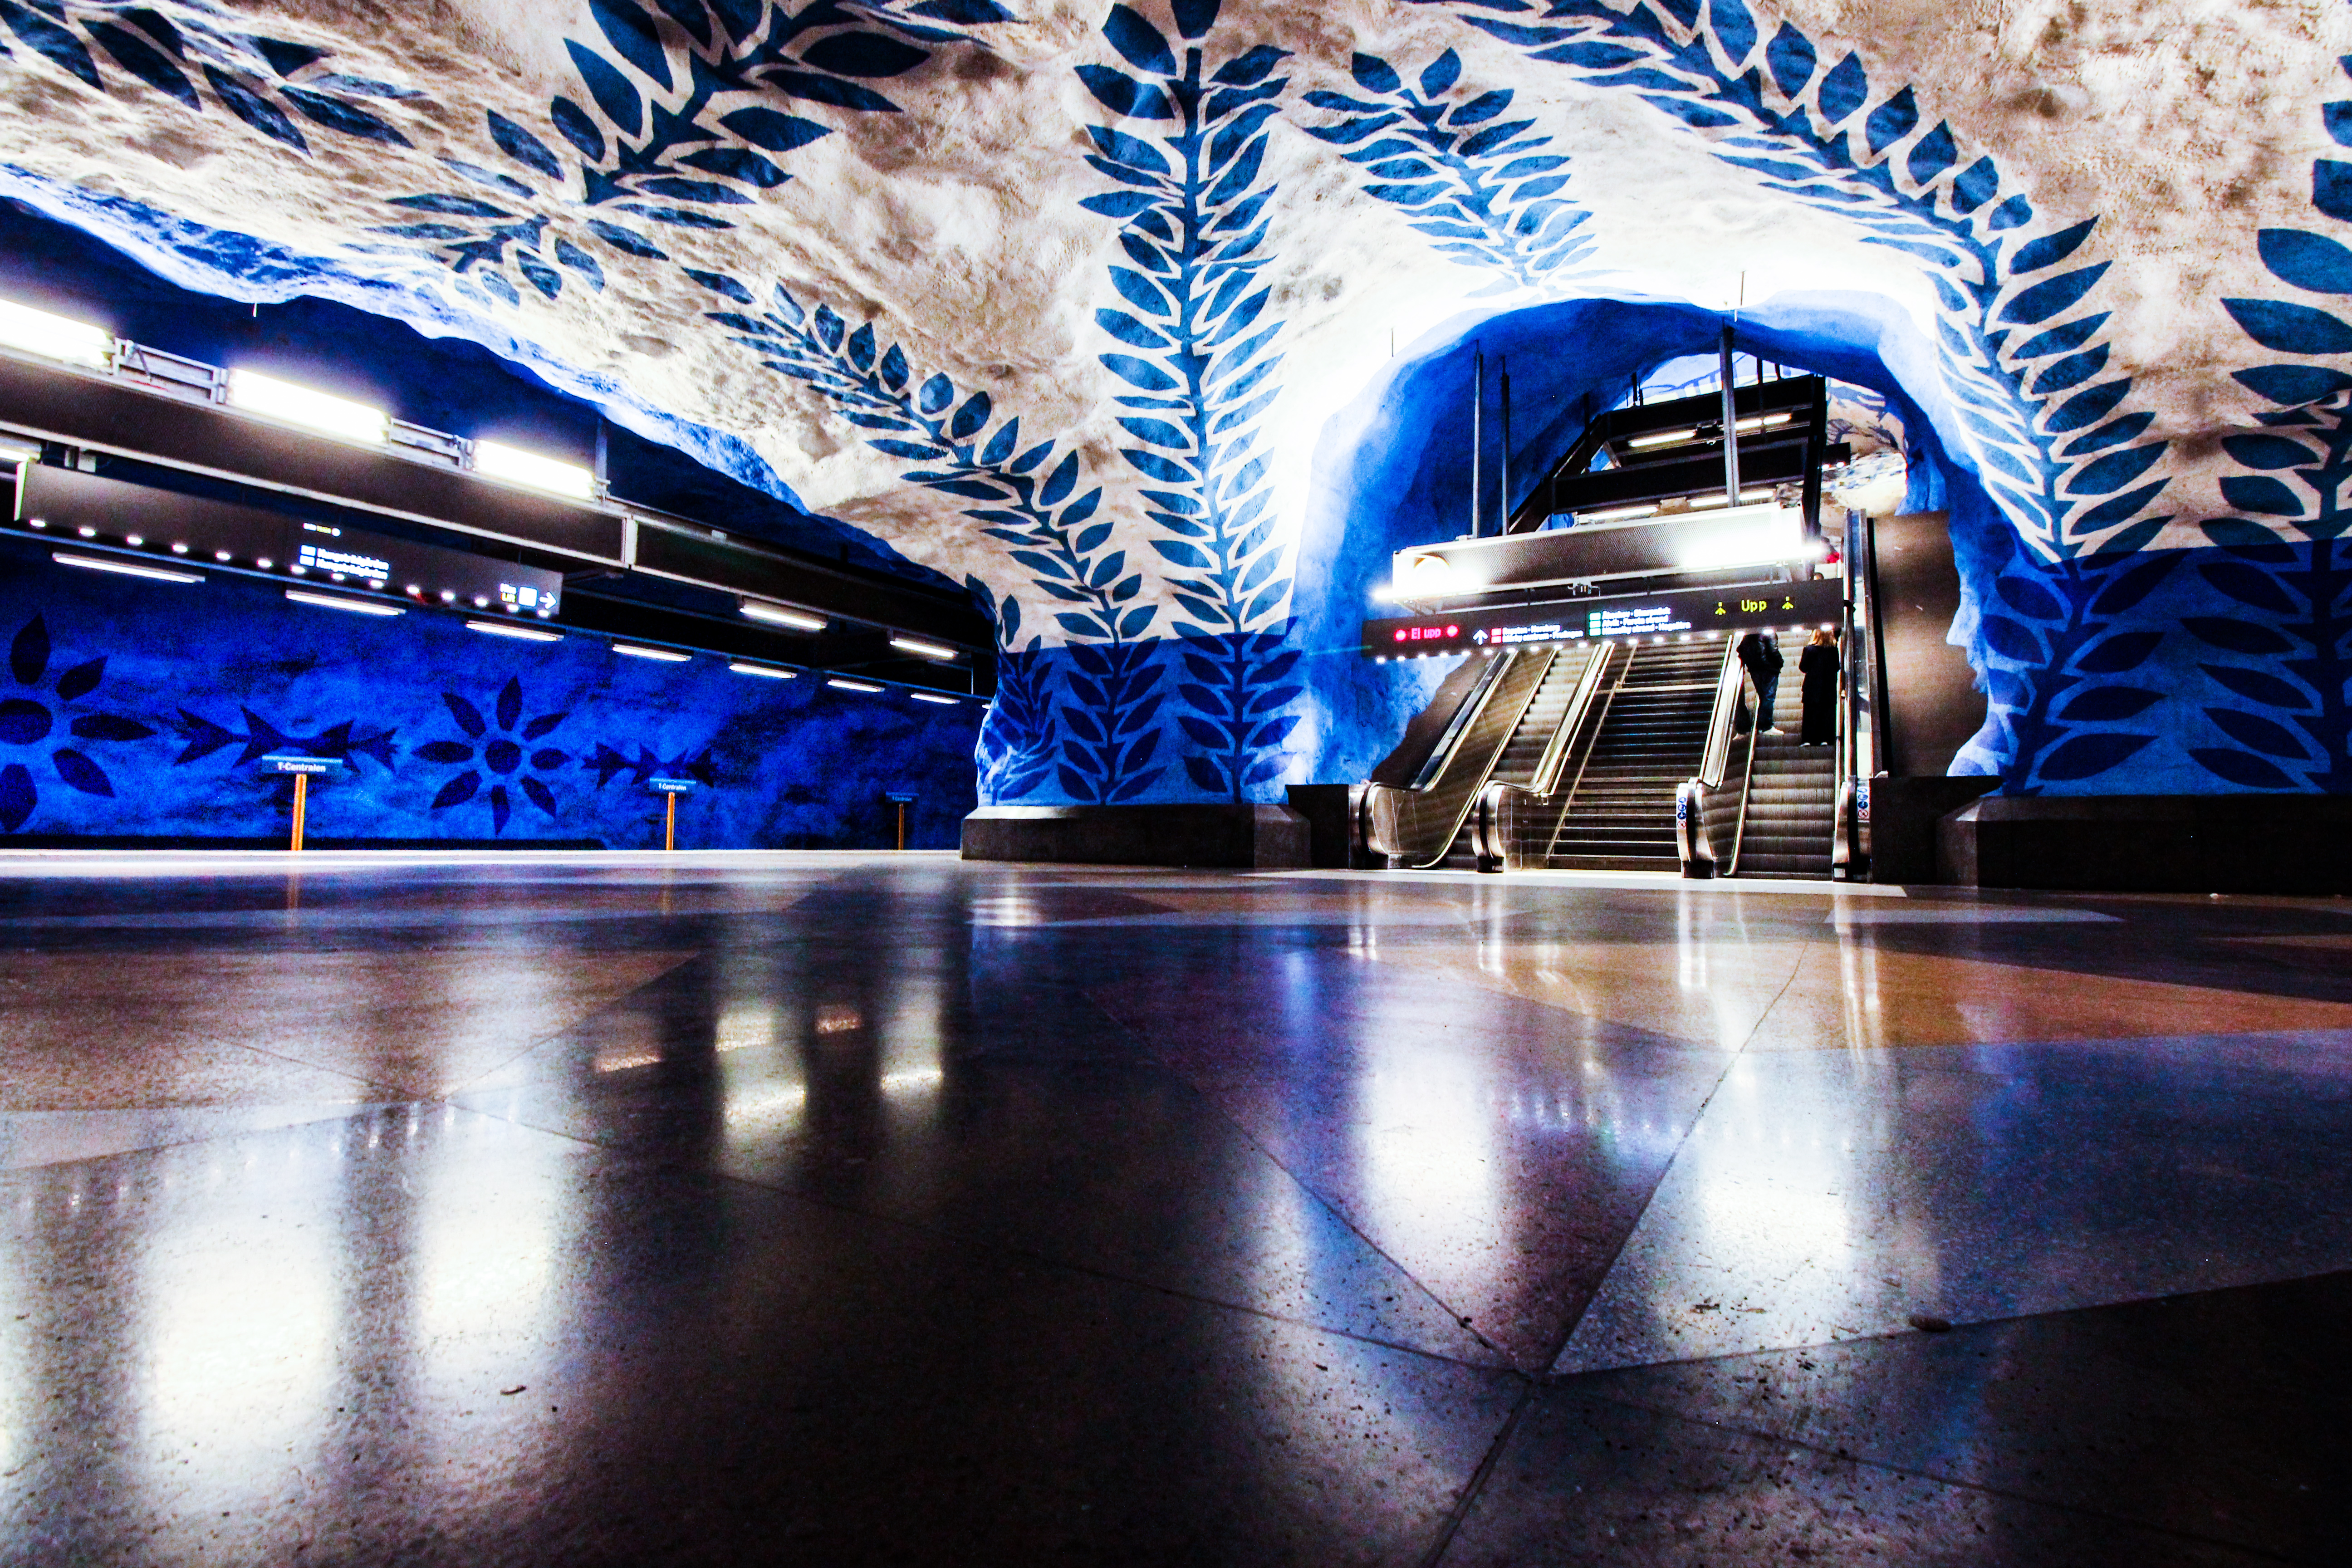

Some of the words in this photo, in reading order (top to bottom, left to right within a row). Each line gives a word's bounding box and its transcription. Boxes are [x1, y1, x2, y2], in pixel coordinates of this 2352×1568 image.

[1741, 599, 1767, 613] Upp
[1423, 628, 1442, 639] upp
[277, 761, 326, 772] T-Centralen
